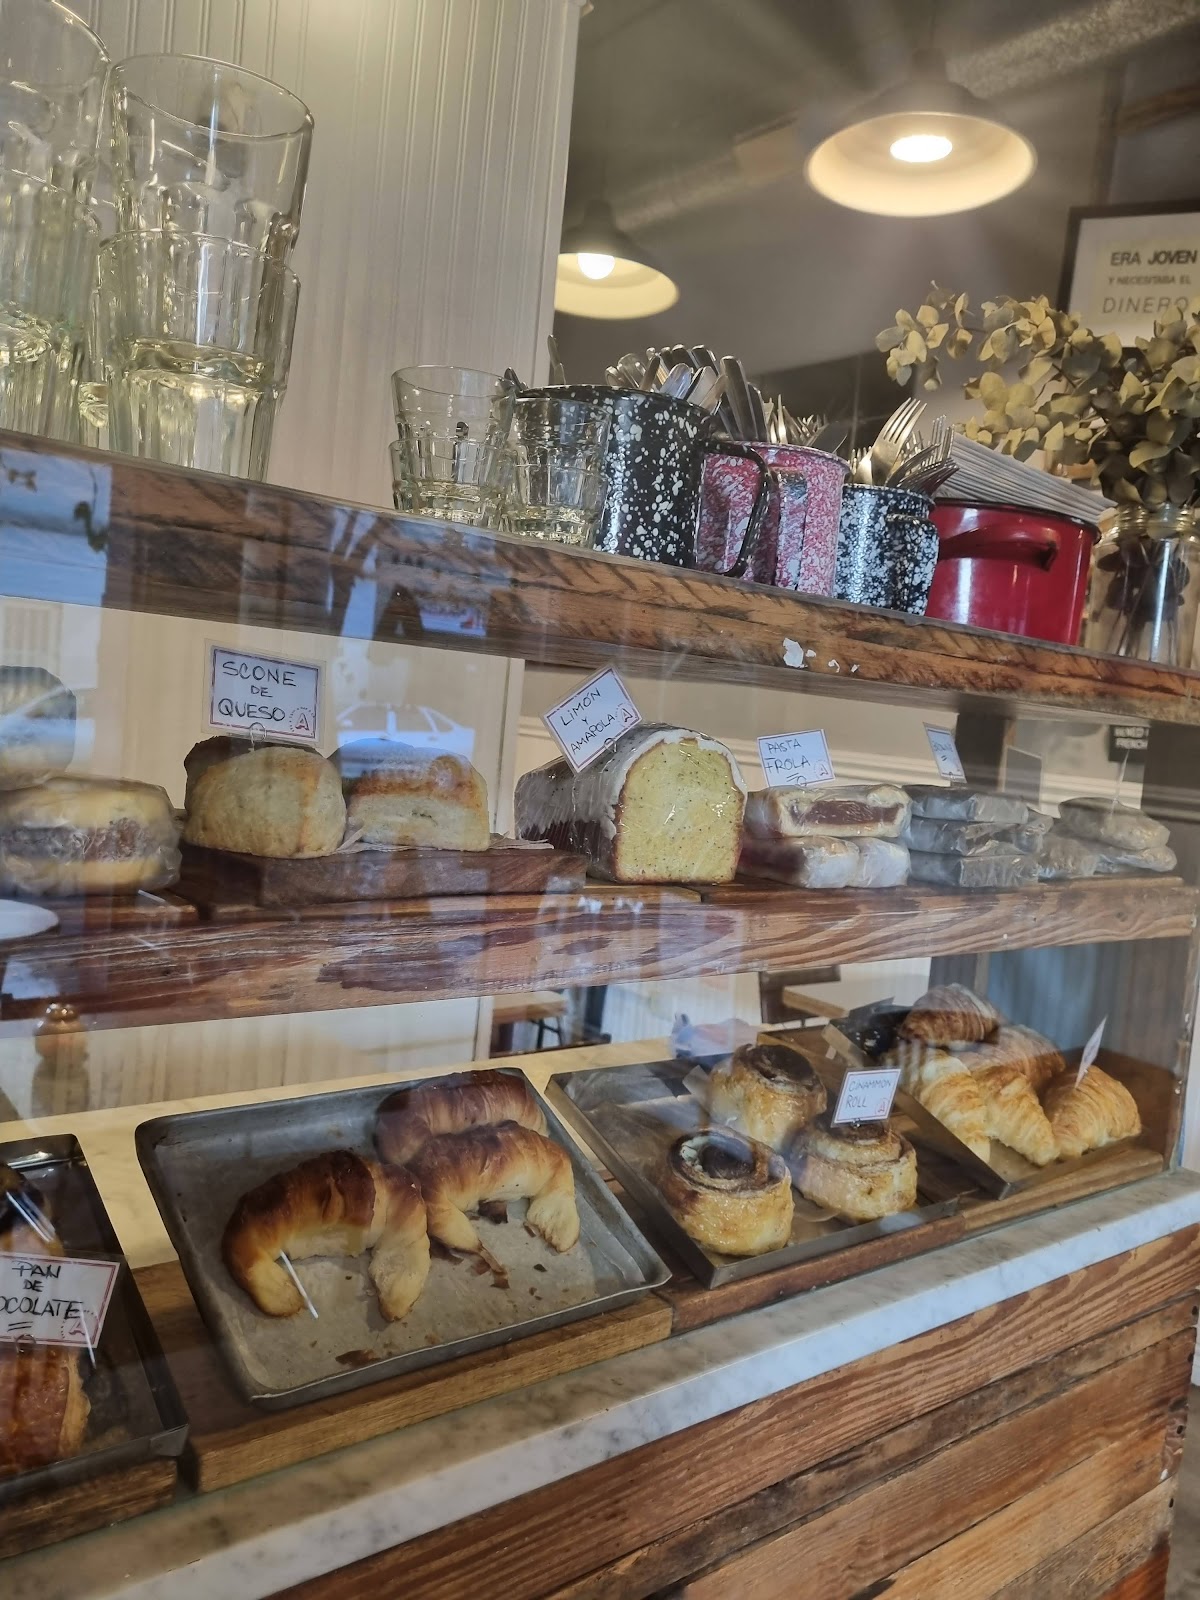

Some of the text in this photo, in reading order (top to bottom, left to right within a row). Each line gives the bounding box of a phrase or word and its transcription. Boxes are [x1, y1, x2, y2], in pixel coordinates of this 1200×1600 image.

[1110, 249, 1198, 266] ERA JOVEN
[1108, 276, 1115, 286] Y
[1102, 296, 1189, 314] DINERO
[222, 661, 296, 687] SCONE
[250, 685, 273, 698] DE
[218, 698, 286, 721] QUESO
[570, 714, 616, 755] AMAPOLA
[765, 738, 802, 754] PASTA
[846, 1094, 868, 1109] ROLL
[12, 1260, 61, 1279] PAN
[23, 1279, 44, 1292] DE
